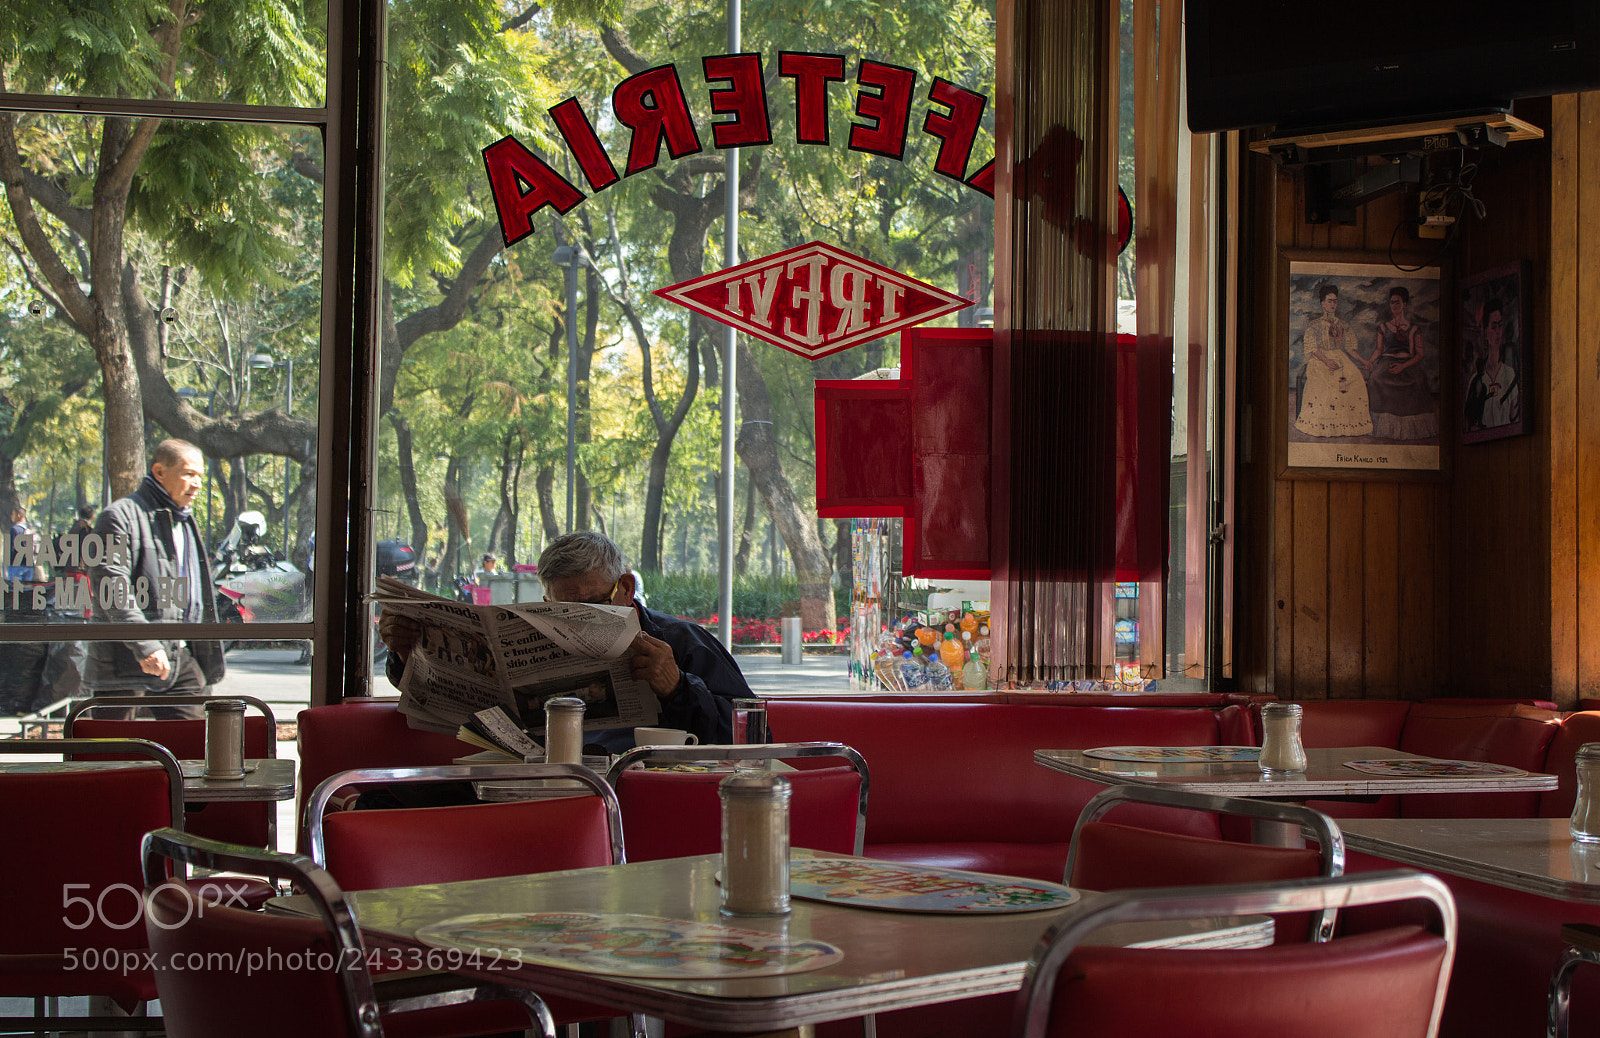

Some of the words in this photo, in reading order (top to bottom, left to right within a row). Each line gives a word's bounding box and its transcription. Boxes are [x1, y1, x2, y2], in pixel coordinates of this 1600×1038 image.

[500, 638, 515, 648] Se
[506, 658, 528, 669] sitio
[530, 655, 548, 665] dos
[549, 651, 561, 660] de
